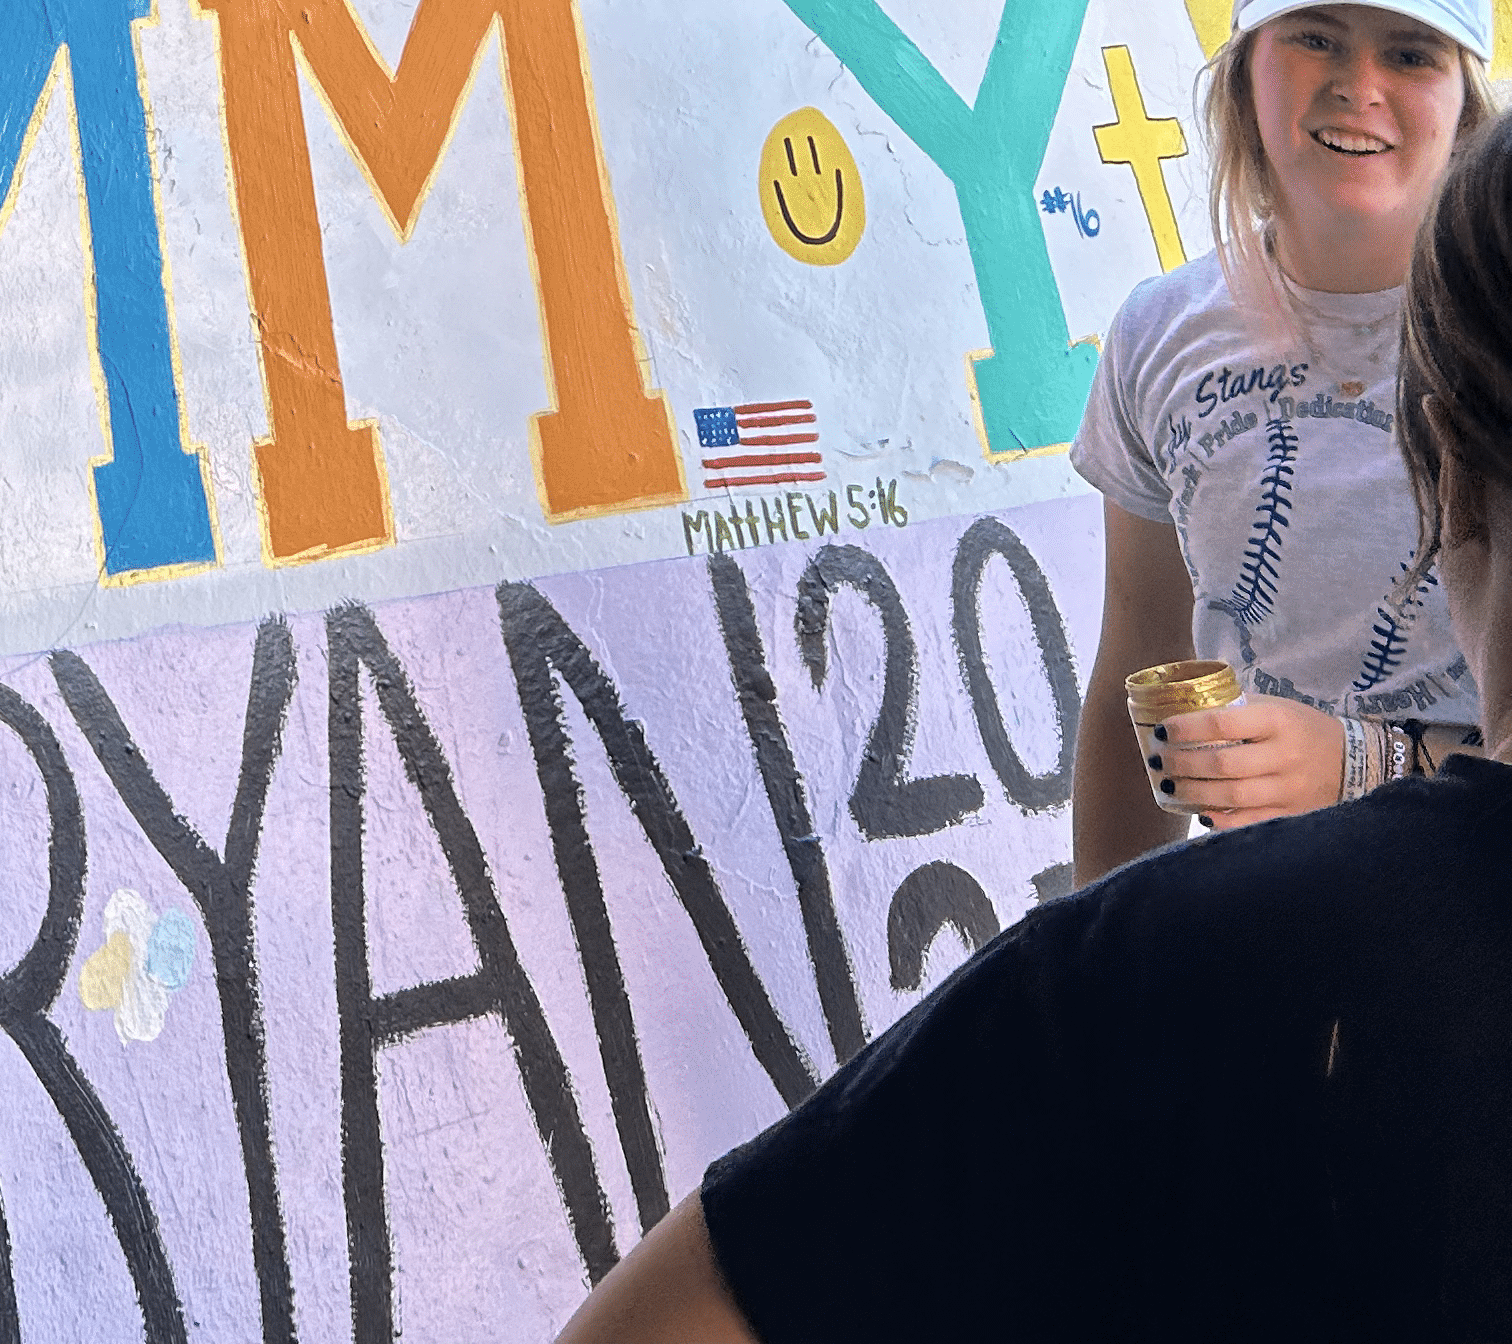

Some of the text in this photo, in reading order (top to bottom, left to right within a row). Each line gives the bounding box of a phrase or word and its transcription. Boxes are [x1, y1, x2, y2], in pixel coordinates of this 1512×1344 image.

[1039, 185, 1101, 240] #16
[1195, 362, 1310, 419] Stangs
[846, 476, 909, 530] 5:16
